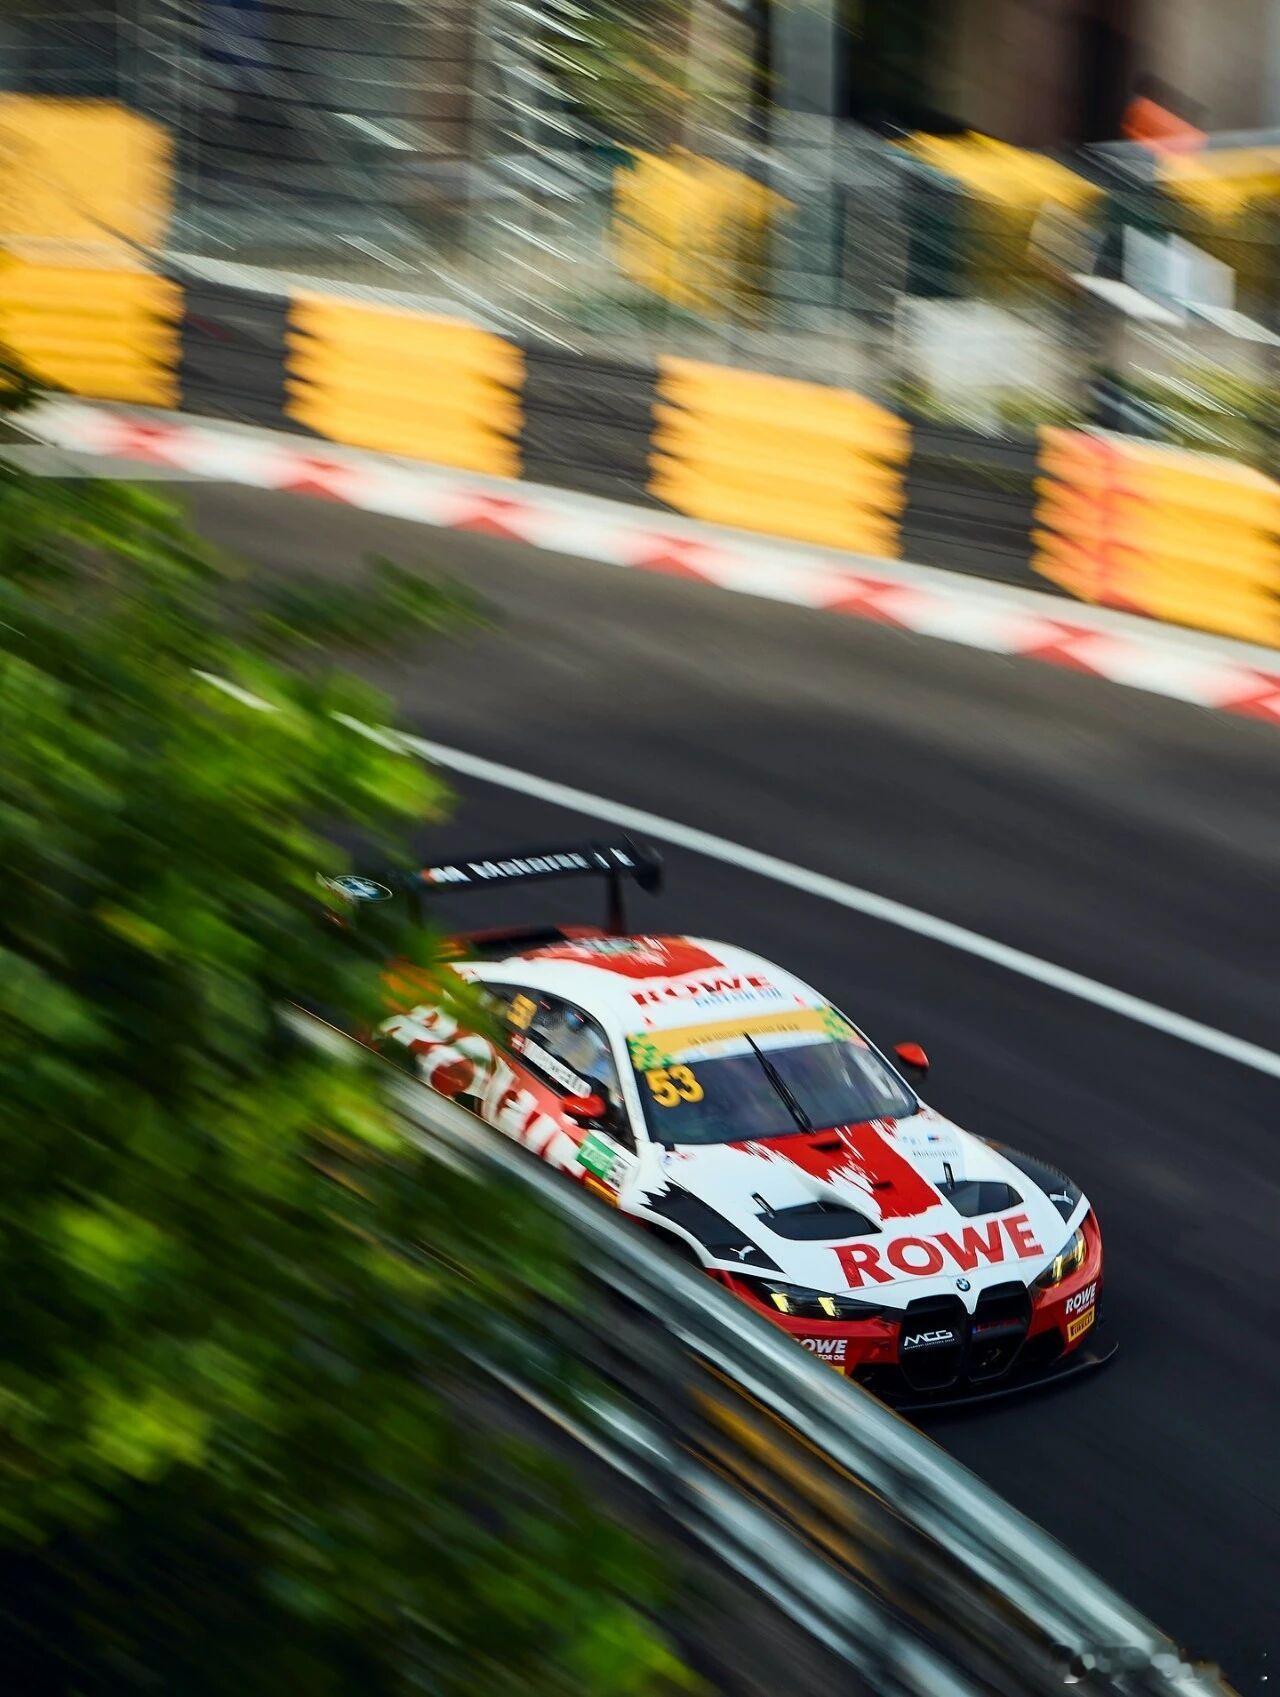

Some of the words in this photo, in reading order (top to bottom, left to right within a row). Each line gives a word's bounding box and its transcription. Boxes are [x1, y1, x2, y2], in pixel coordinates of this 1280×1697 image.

[645, 1064, 705, 1108] 53
[826, 1214, 1045, 1288] ROWE
[1065, 1281, 1097, 1315] ROWE
[903, 1329, 954, 1347] MCG
